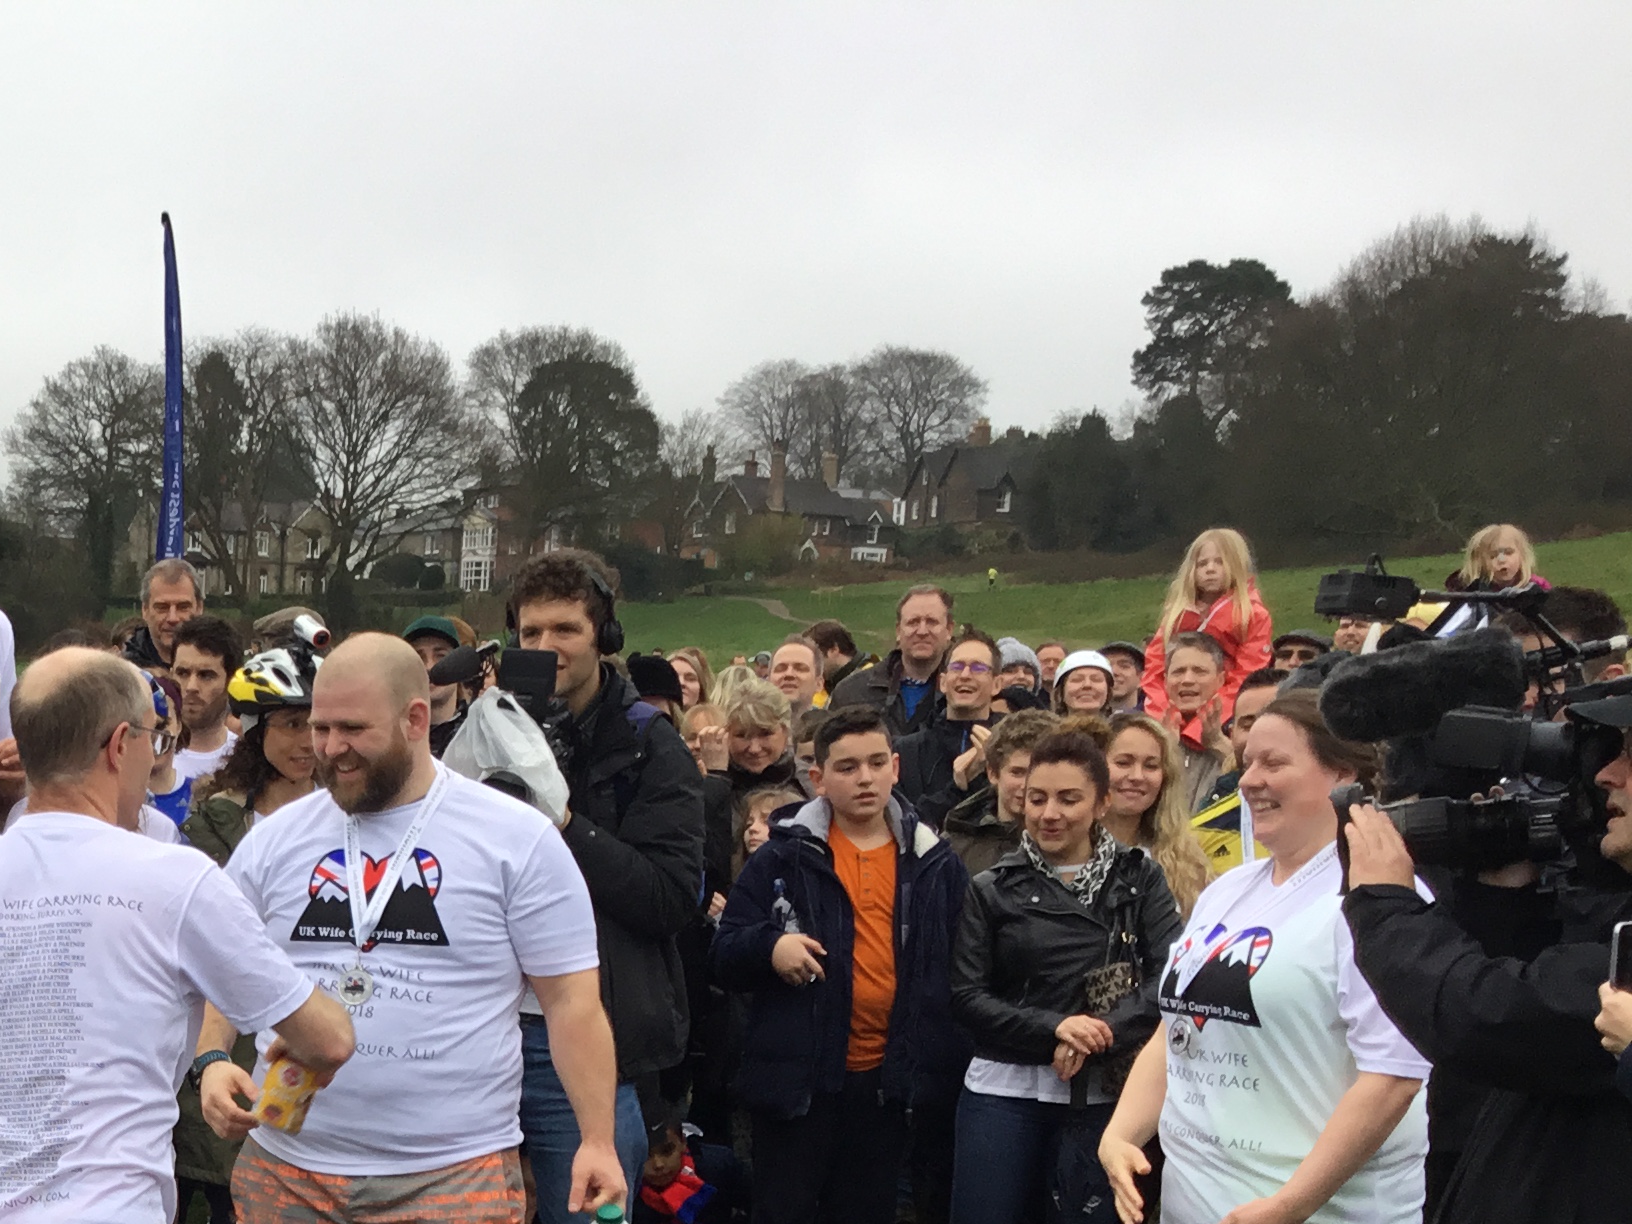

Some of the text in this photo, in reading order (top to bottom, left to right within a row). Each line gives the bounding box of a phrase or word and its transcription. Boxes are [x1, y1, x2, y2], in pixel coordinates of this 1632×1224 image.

[3, 898, 34, 911] WIFE
[36, 894, 102, 908] CARRYING
[107, 896, 144, 913] RACE
[68, 908, 83, 917] UK
[298, 926, 316, 937] UK
[318, 926, 346, 938] Wife
[406, 929, 439, 941] Race
[389, 985, 433, 1003] RACE
[346, 1005, 374, 1018] 018
[1188, 1001, 1222, 1015] Carrying
[1223, 1006, 1250, 1021] Race
[1211, 1051, 1248, 1068] WIFE
[1219, 1073, 1260, 1092] RACE
[1228, 1139, 1262, 1152] ALL!
